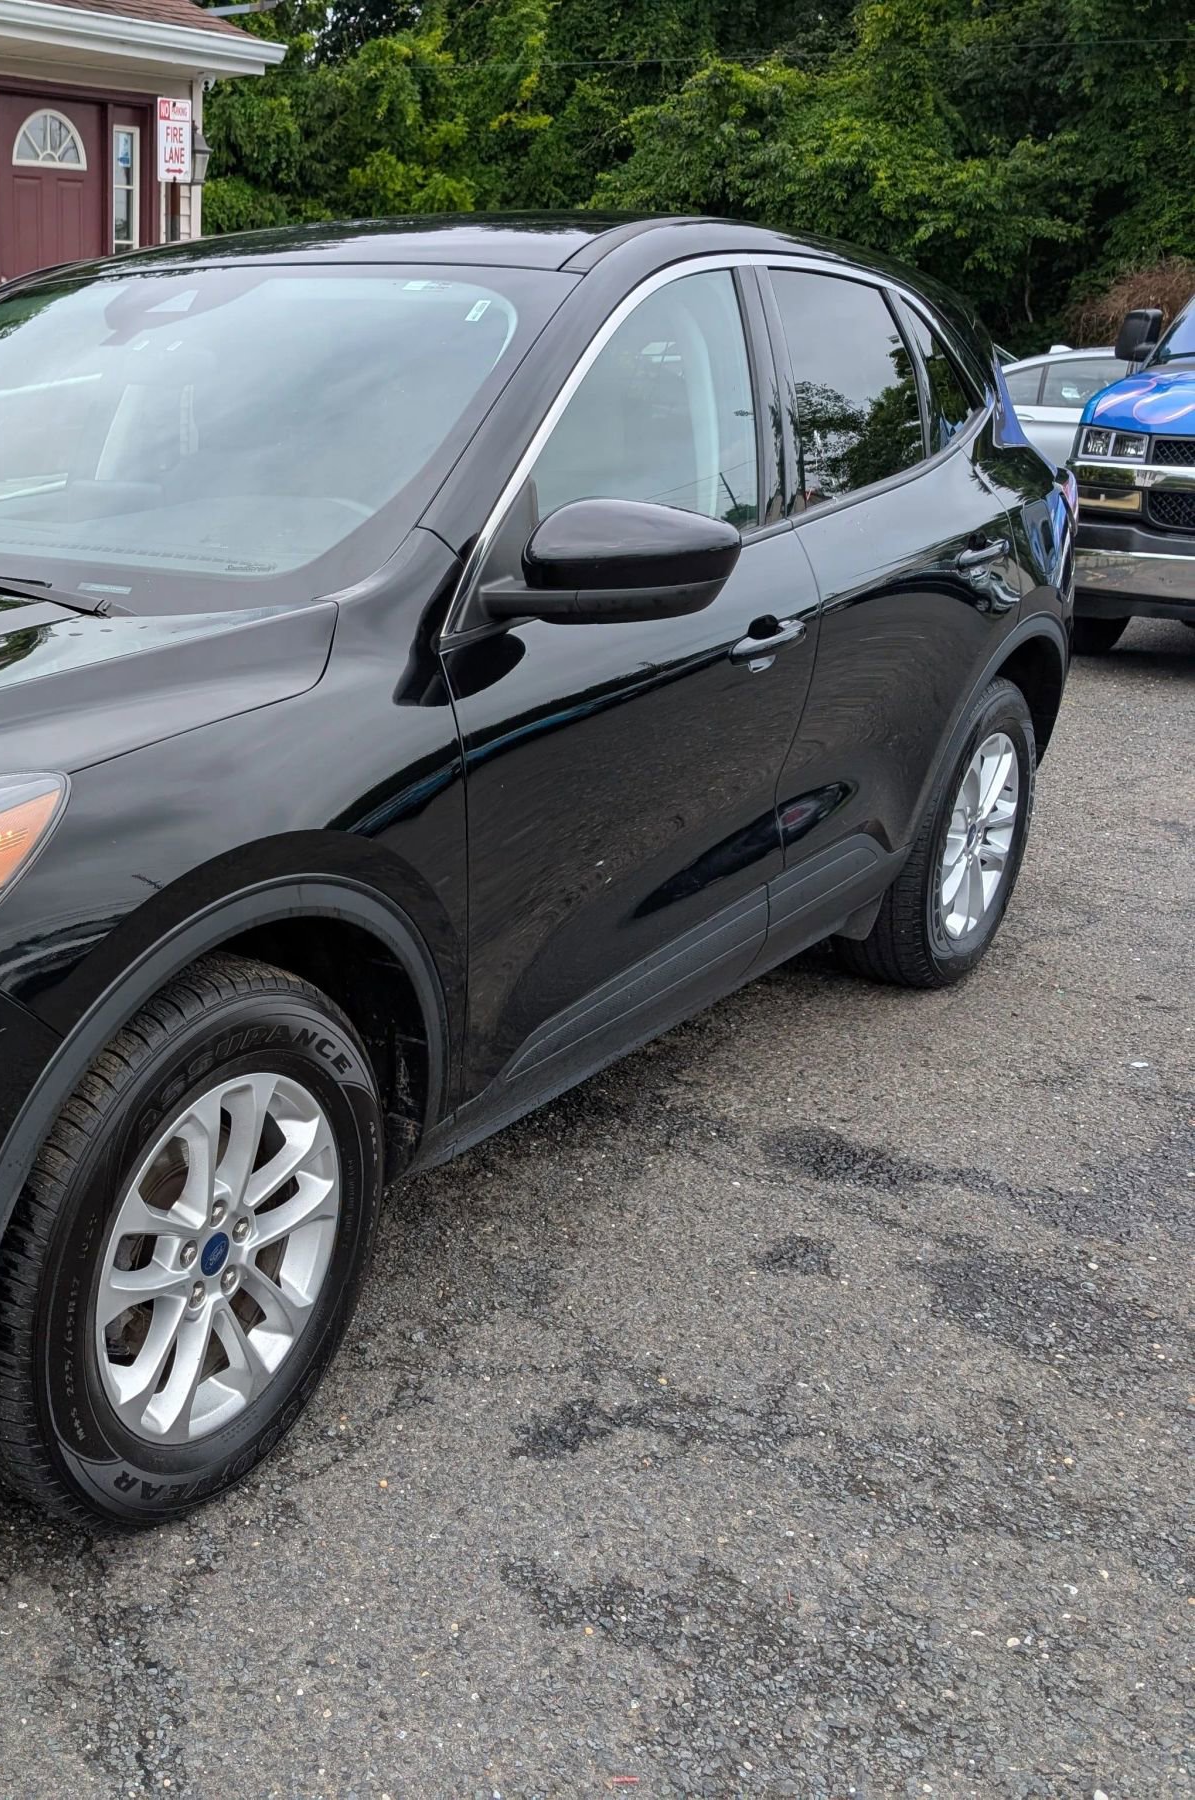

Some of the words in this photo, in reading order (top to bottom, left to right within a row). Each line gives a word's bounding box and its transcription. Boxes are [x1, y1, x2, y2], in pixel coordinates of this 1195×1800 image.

[160, 101, 170, 118] NO
[165, 126, 184, 144] FIRE
[164, 147, 185, 164] LANE
[138, 1023, 353, 1132] ASSURANCE
